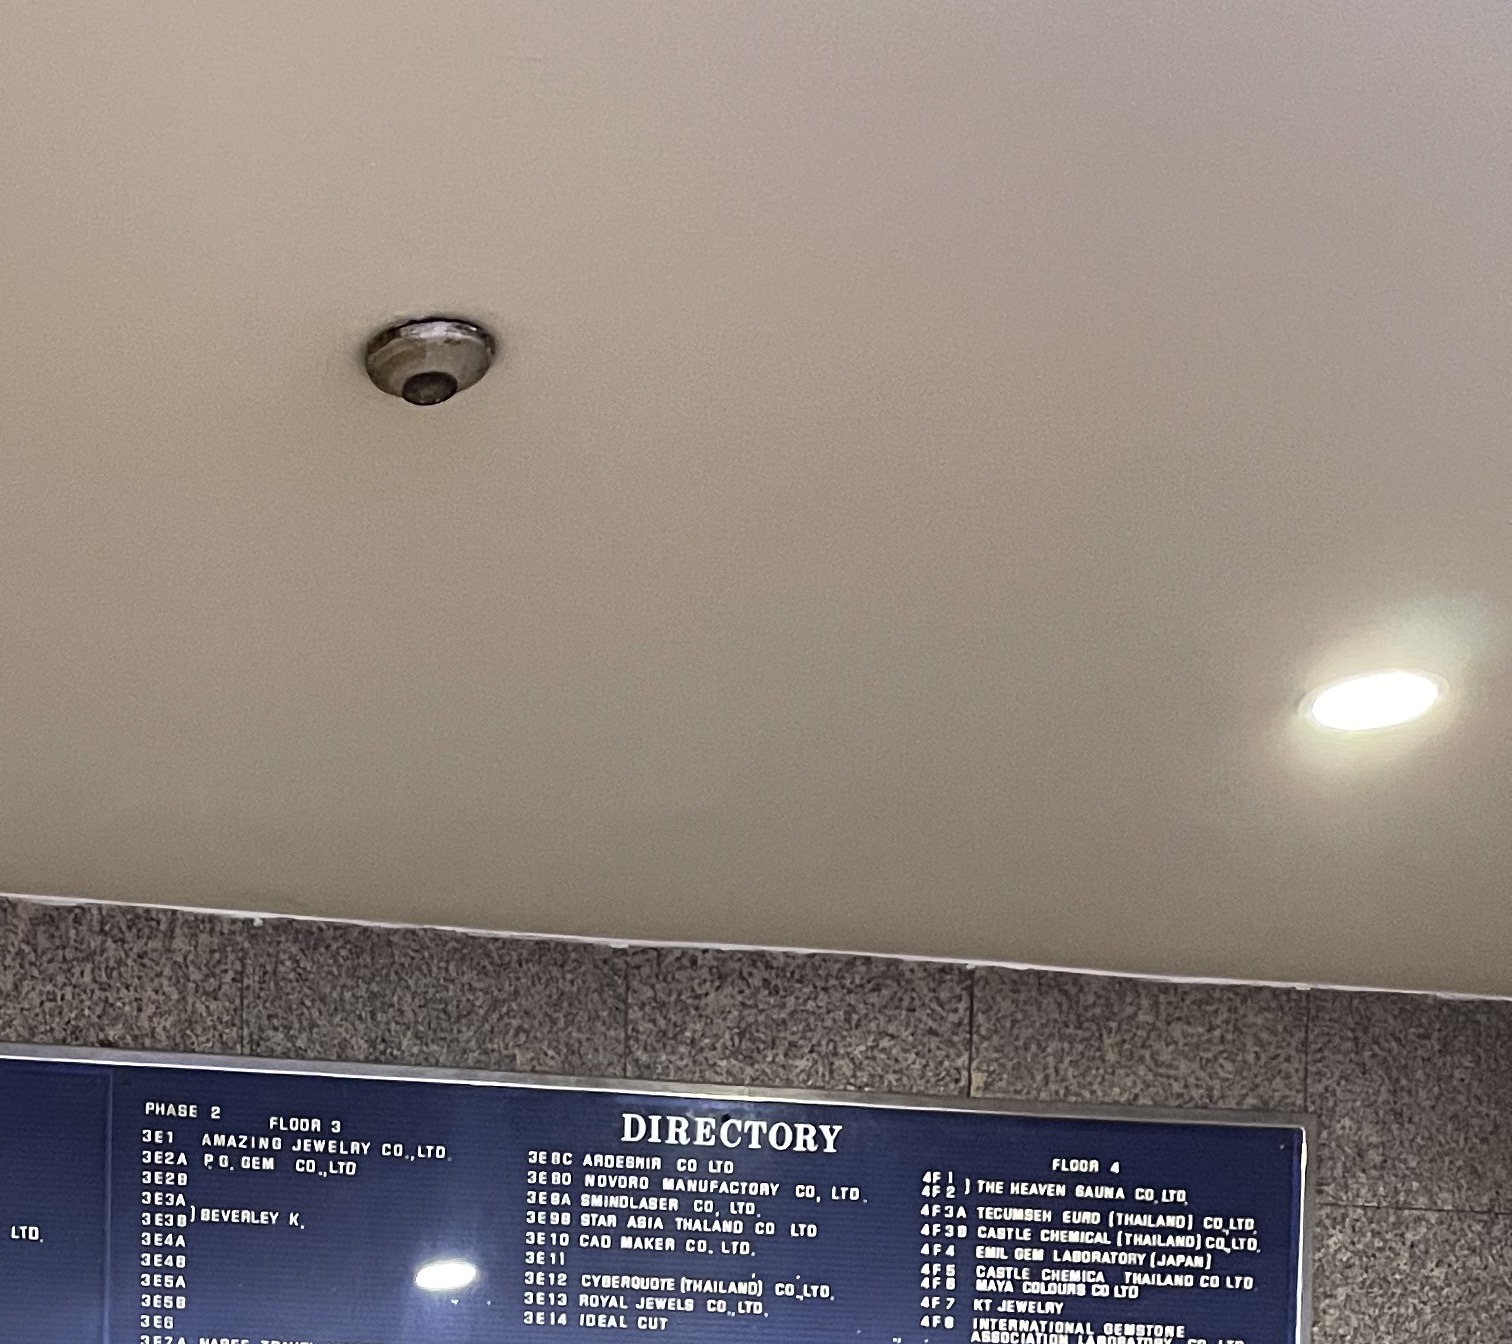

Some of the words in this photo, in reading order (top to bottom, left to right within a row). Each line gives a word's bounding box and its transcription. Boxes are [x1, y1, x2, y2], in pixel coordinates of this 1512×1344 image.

[145, 1102, 197, 1118] PHASE
[211, 1106, 220, 1119] 2
[269, 1116, 321, 1132] FLOOR
[331, 1120, 341, 1133] 3
[621, 1113, 843, 1153] DIRECTORY
[142, 1129, 173, 1143] 3E1
[202, 1133, 281, 1150] AMAZING
[292, 1139, 371, 1155] JEWELRY
[142, 1150, 187, 1166] 3E2A
[241, 1156, 274, 1170] GEM
[677, 1158, 697, 1172] CO
[708, 1160, 734, 1174] LTD
[1052, 1158, 1099, 1173] FLOOR
[1110, 1161, 1119, 1174] 4
[662, 1178, 779, 1196] MANUFACTORY
[977, 1179, 1004, 1194] THE
[1010, 1182, 1066, 1197] HEAVEN
[1075, 1185, 1125, 1199] SAUNA
[141, 1191, 186, 1206] 3E3A
[201, 1208, 279, 1224] BEVERLEY
[289, 1212, 305, 1229] K.
[976, 1207, 1052, 1222] TECUMSEH
[1062, 1210, 1101, 1225] EURO
[581, 1213, 617, 1227] STAR
[627, 1215, 663, 1229] ASIA
[675, 1217, 743, 1234] THALAND
[755, 1222, 775, 1235] CO
[790, 1223, 817, 1237] LTD
[141, 1232, 185, 1247] 3E4A
[579, 1234, 611, 1248] CAD
[620, 1236, 675, 1251] MAKER
[977, 1226, 1031, 1241] CASTLE
[1040, 1229, 1111, 1245] CHEMICAL
[976, 1245, 1008, 1259] EMIL
[1014, 1247, 1044, 1261] GEM
[141, 1273, 186, 1288] 3E5A
[581, 1274, 675, 1291] CYBERQUOTE
[680, 1276, 763, 1297] (THAILAND)
[976, 1265, 1030, 1280] CASTLE
[1124, 1271, 1194, 1287] THAILAND
[1199, 1275, 1219, 1288] CO
[1226, 1276, 1253, 1290] LTD
[976, 1279, 1014, 1293] MAYA
[1022, 1281, 1086, 1296] COLOURS
[579, 1294, 628, 1309] ROYAL
[635, 1297, 694, 1311] JEWELS
[974, 1299, 993, 1311] KT
[997, 1300, 1064, 1315] JEWELRY
[140, 1315, 173, 1329] 3E6
[580, 1314, 627, 1328] IDEAL
[638, 1316, 668, 1330] CUT
